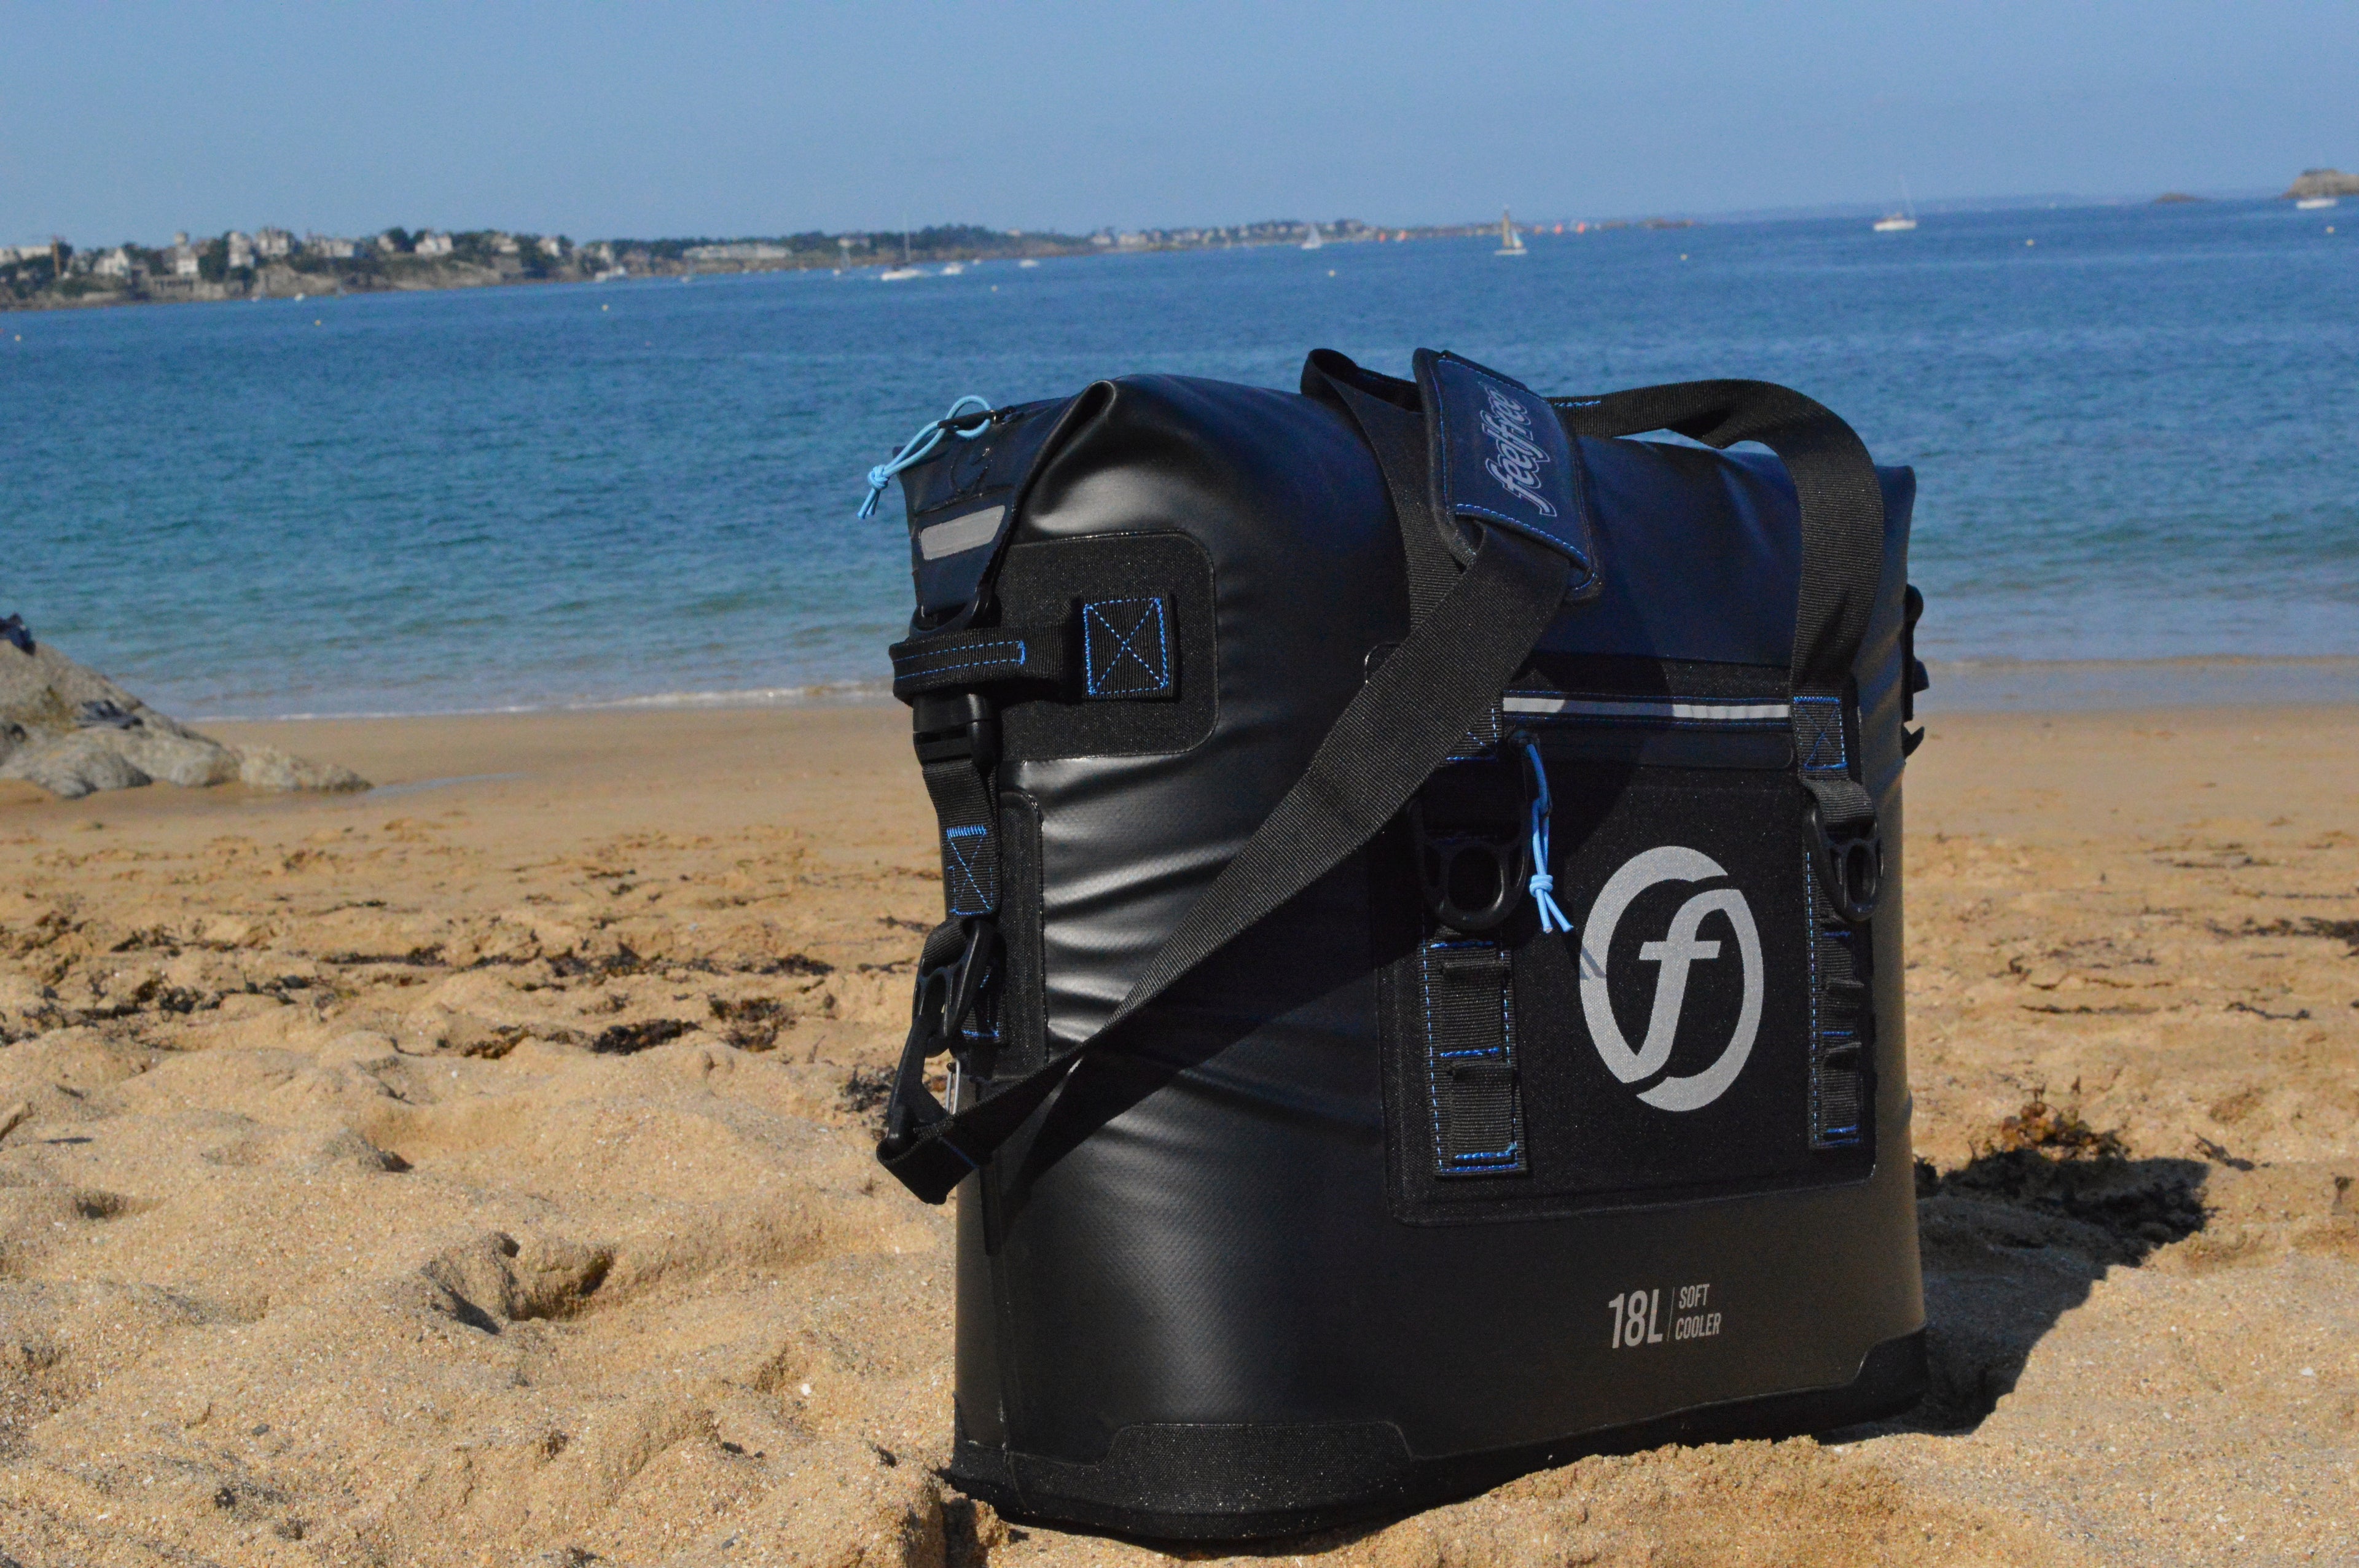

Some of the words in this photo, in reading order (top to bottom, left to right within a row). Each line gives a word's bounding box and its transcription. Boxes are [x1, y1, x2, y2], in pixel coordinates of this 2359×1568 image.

[1479, 382, 1557, 517] feelfree
[1679, 1284, 1710, 1309] SOFT
[1608, 1289, 1663, 1349] 18L
[1675, 1313, 1721, 1340] COOLER
